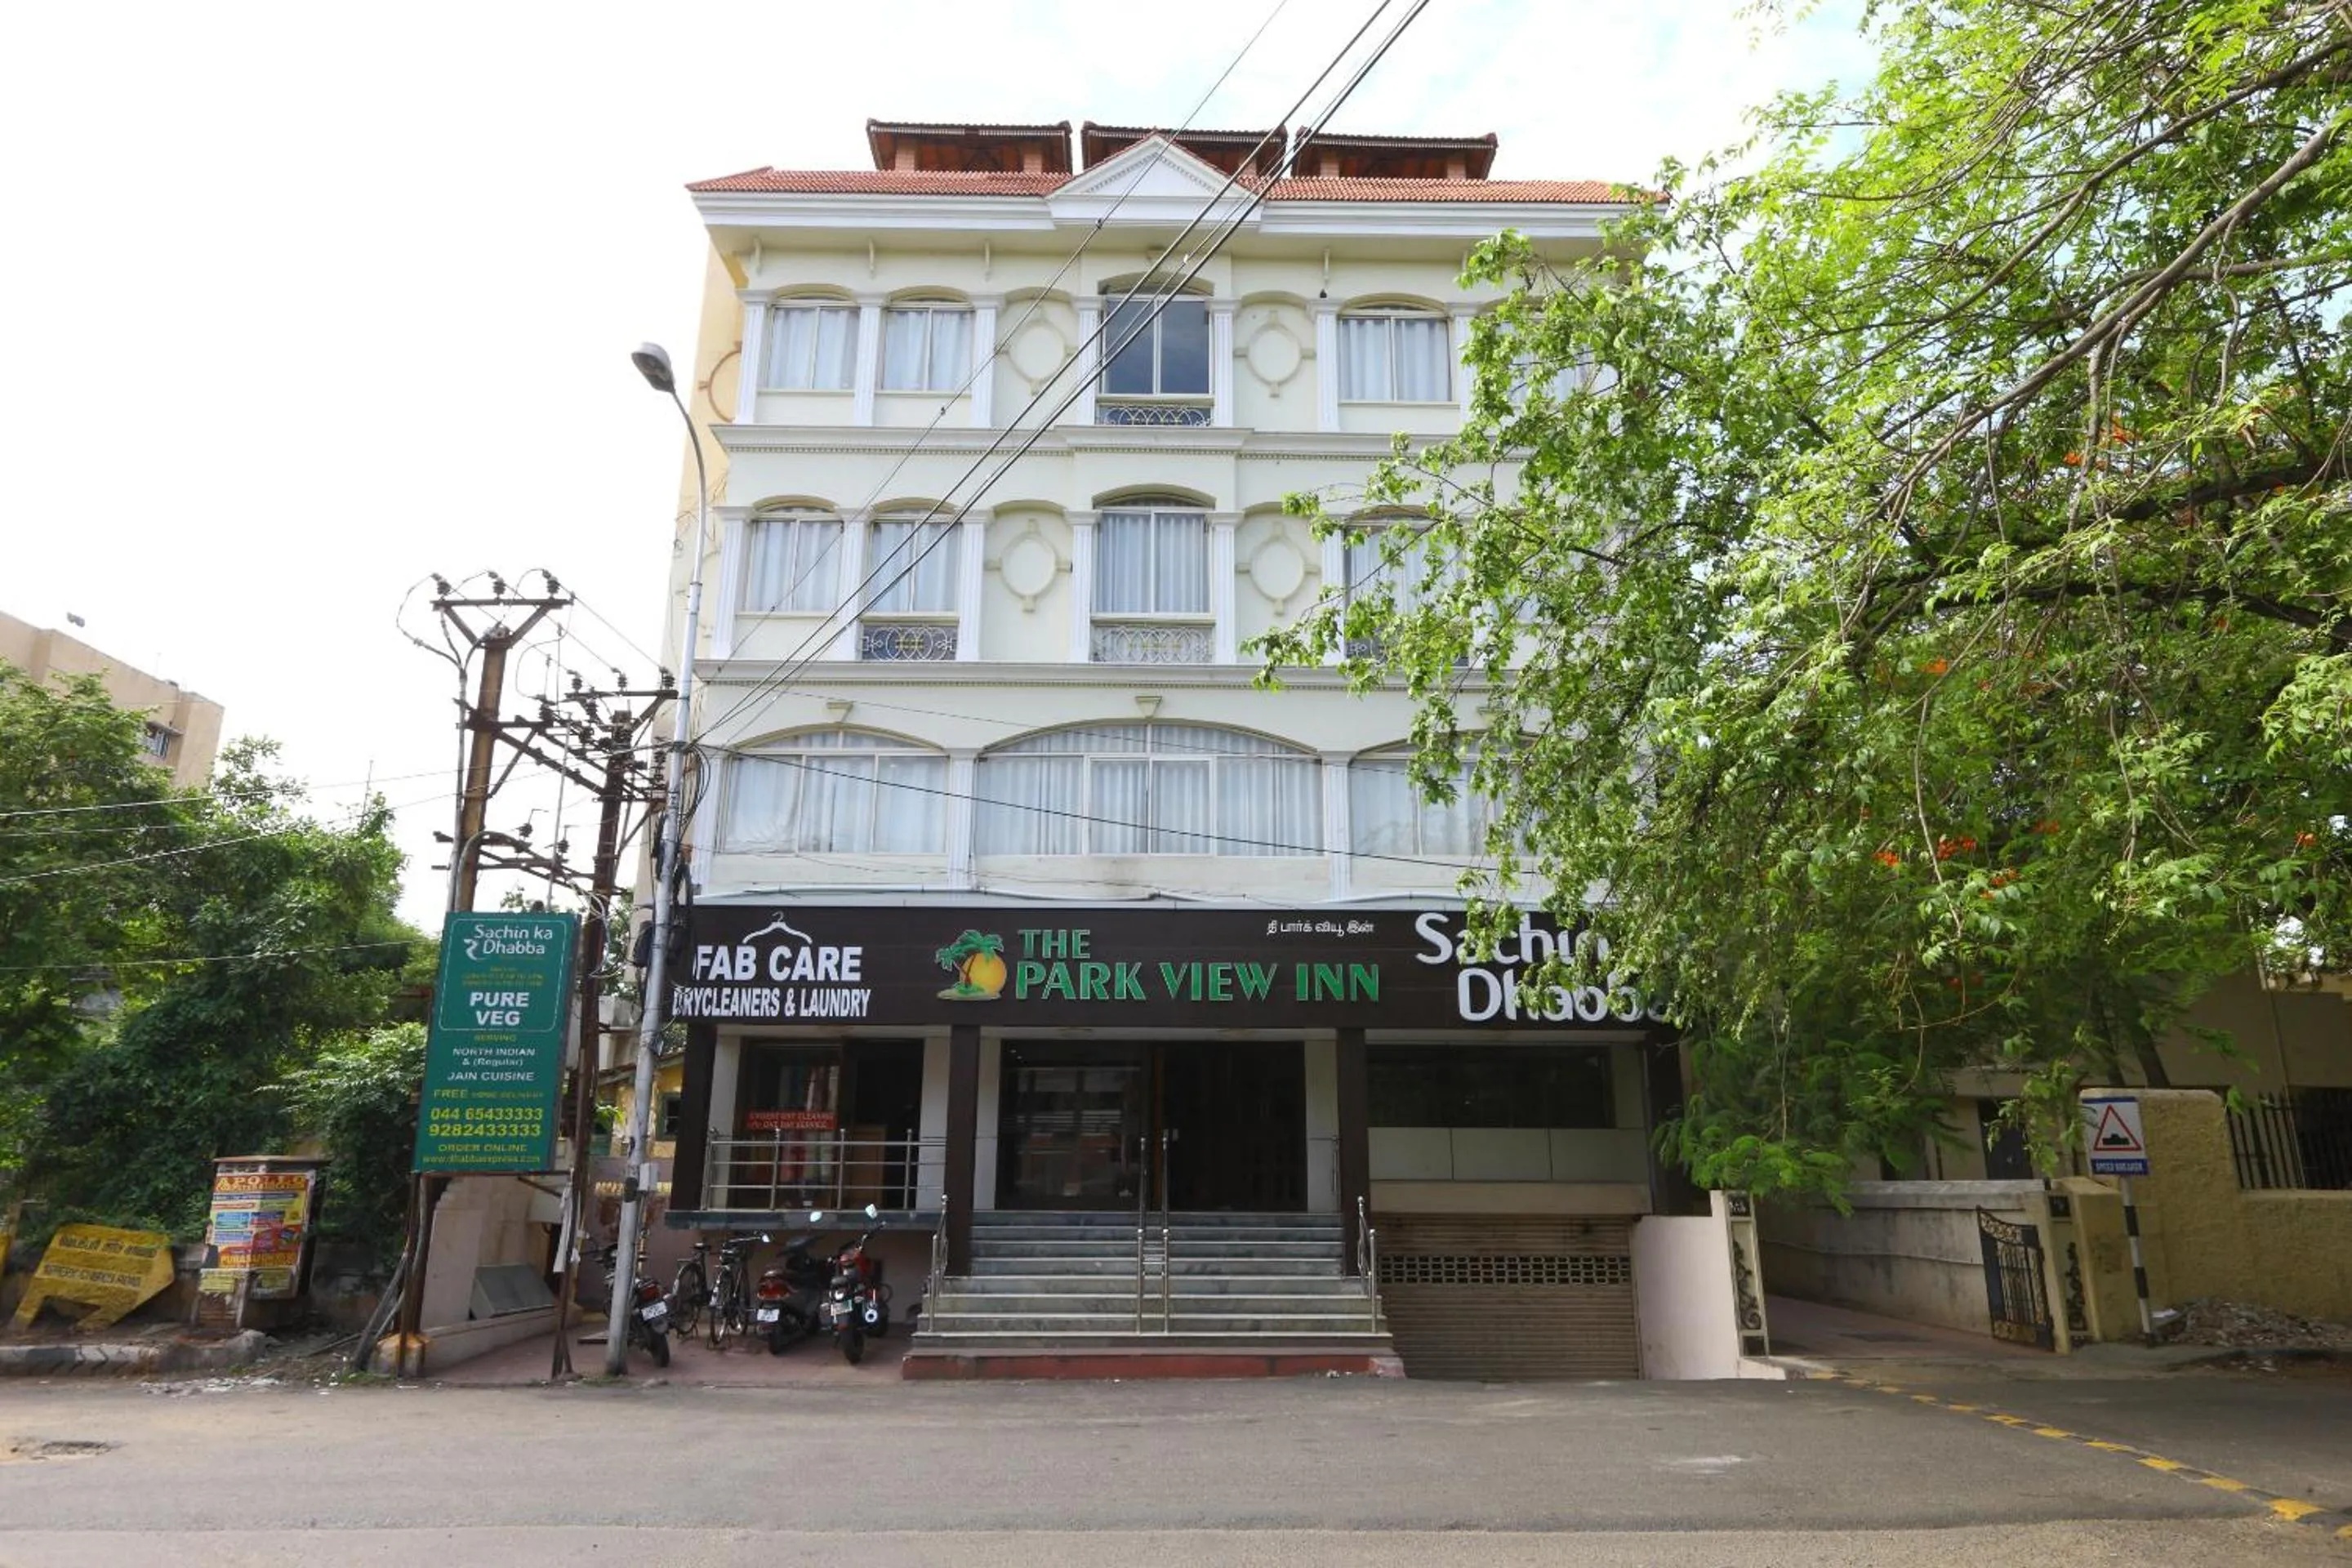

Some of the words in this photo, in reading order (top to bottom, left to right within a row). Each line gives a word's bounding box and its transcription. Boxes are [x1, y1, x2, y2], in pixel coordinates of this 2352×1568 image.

[474, 924, 529, 939] Sachin
[534, 924, 553, 940] ka
[483, 939, 546, 955] Dhabba
[1017, 929, 1091, 960] THE
[693, 945, 757, 981] FAB
[768, 945, 863, 982] CARE
[1015, 960, 1146, 1001] PARK
[1158, 961, 1278, 1003] VIEW
[1295, 962, 1379, 1003] INN
[469, 991, 530, 1008] PURE
[672, 987, 781, 1018] DRYCLEANERS
[784, 987, 796, 1018] &
[800, 987, 871, 1018] LAUNDRY
[475, 1010, 521, 1027] VEG
[452, 1048, 493, 1056] NORTH
[495, 1048, 536, 1056] INDIAN
[447, 1071, 478, 1081] JAIN
[480, 1071, 536, 1081] CUISINE
[433, 1089, 469, 1099] FREE
[430, 1107, 461, 1120] 044
[465, 1107, 544, 1120] 65433333
[428, 1123, 541, 1137] 9282433333
[438, 1143, 481, 1152] ORDER
[483, 1144, 528, 1152] ONLINE
